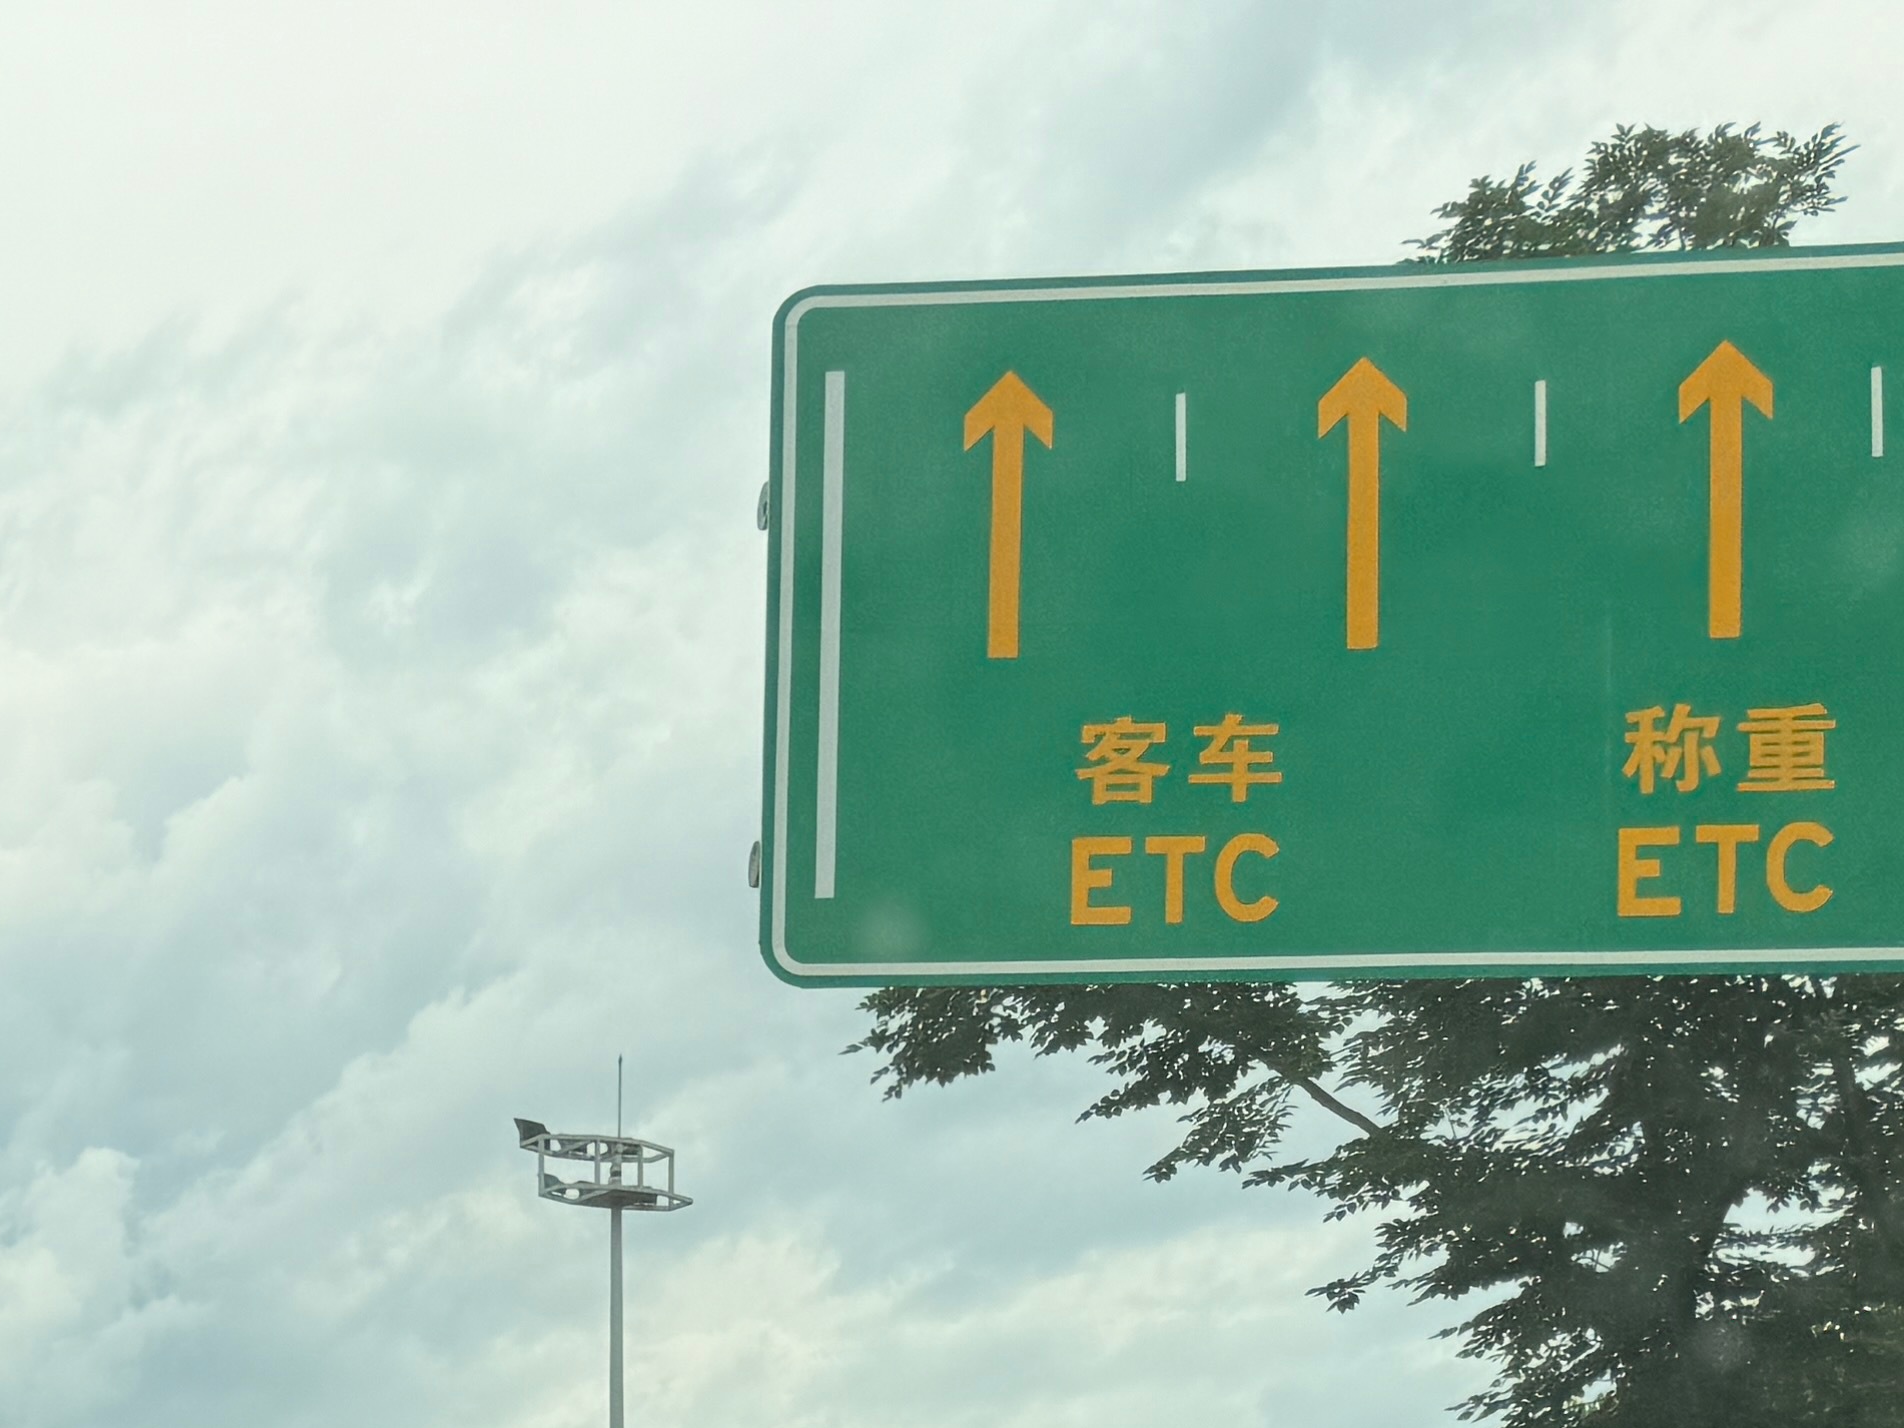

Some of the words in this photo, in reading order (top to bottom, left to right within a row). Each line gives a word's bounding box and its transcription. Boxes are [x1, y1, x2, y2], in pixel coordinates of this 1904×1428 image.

[1074, 712, 1283, 805] 客车
[1620, 703, 1838, 797] 称重
[1070, 833, 1281, 927] ETC
[1615, 821, 1834, 918] ETC
